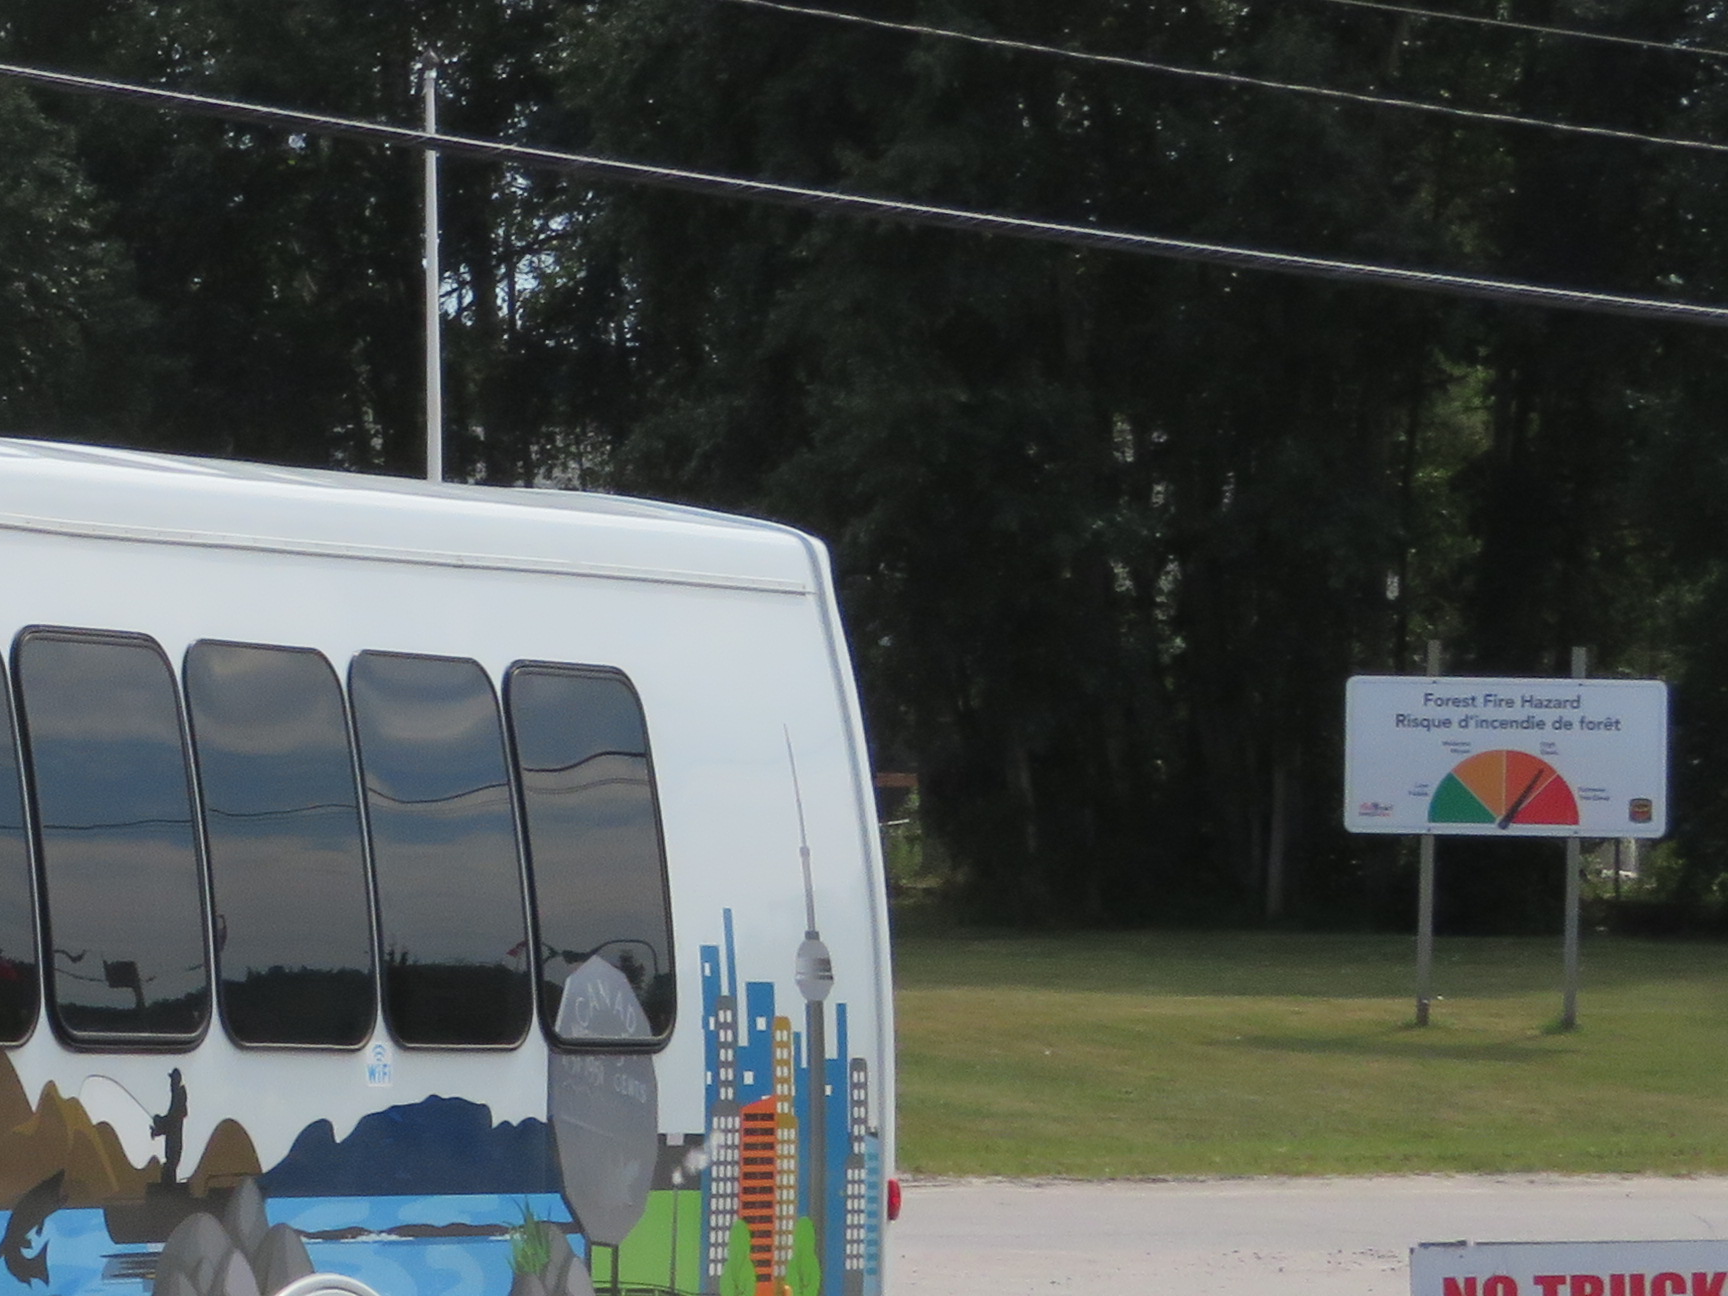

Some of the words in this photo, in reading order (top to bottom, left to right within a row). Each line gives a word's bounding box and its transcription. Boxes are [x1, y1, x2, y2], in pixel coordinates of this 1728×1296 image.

[1422, 692, 1478, 709] Forest
[1482, 693, 1516, 709] Fire
[1520, 694, 1582, 710] Hazard
[1395, 713, 1453, 732] Risque
[1458, 714, 1547, 731] d'incendie
[1551, 716, 1574, 731] de
[1579, 715, 1623, 732] forêt
